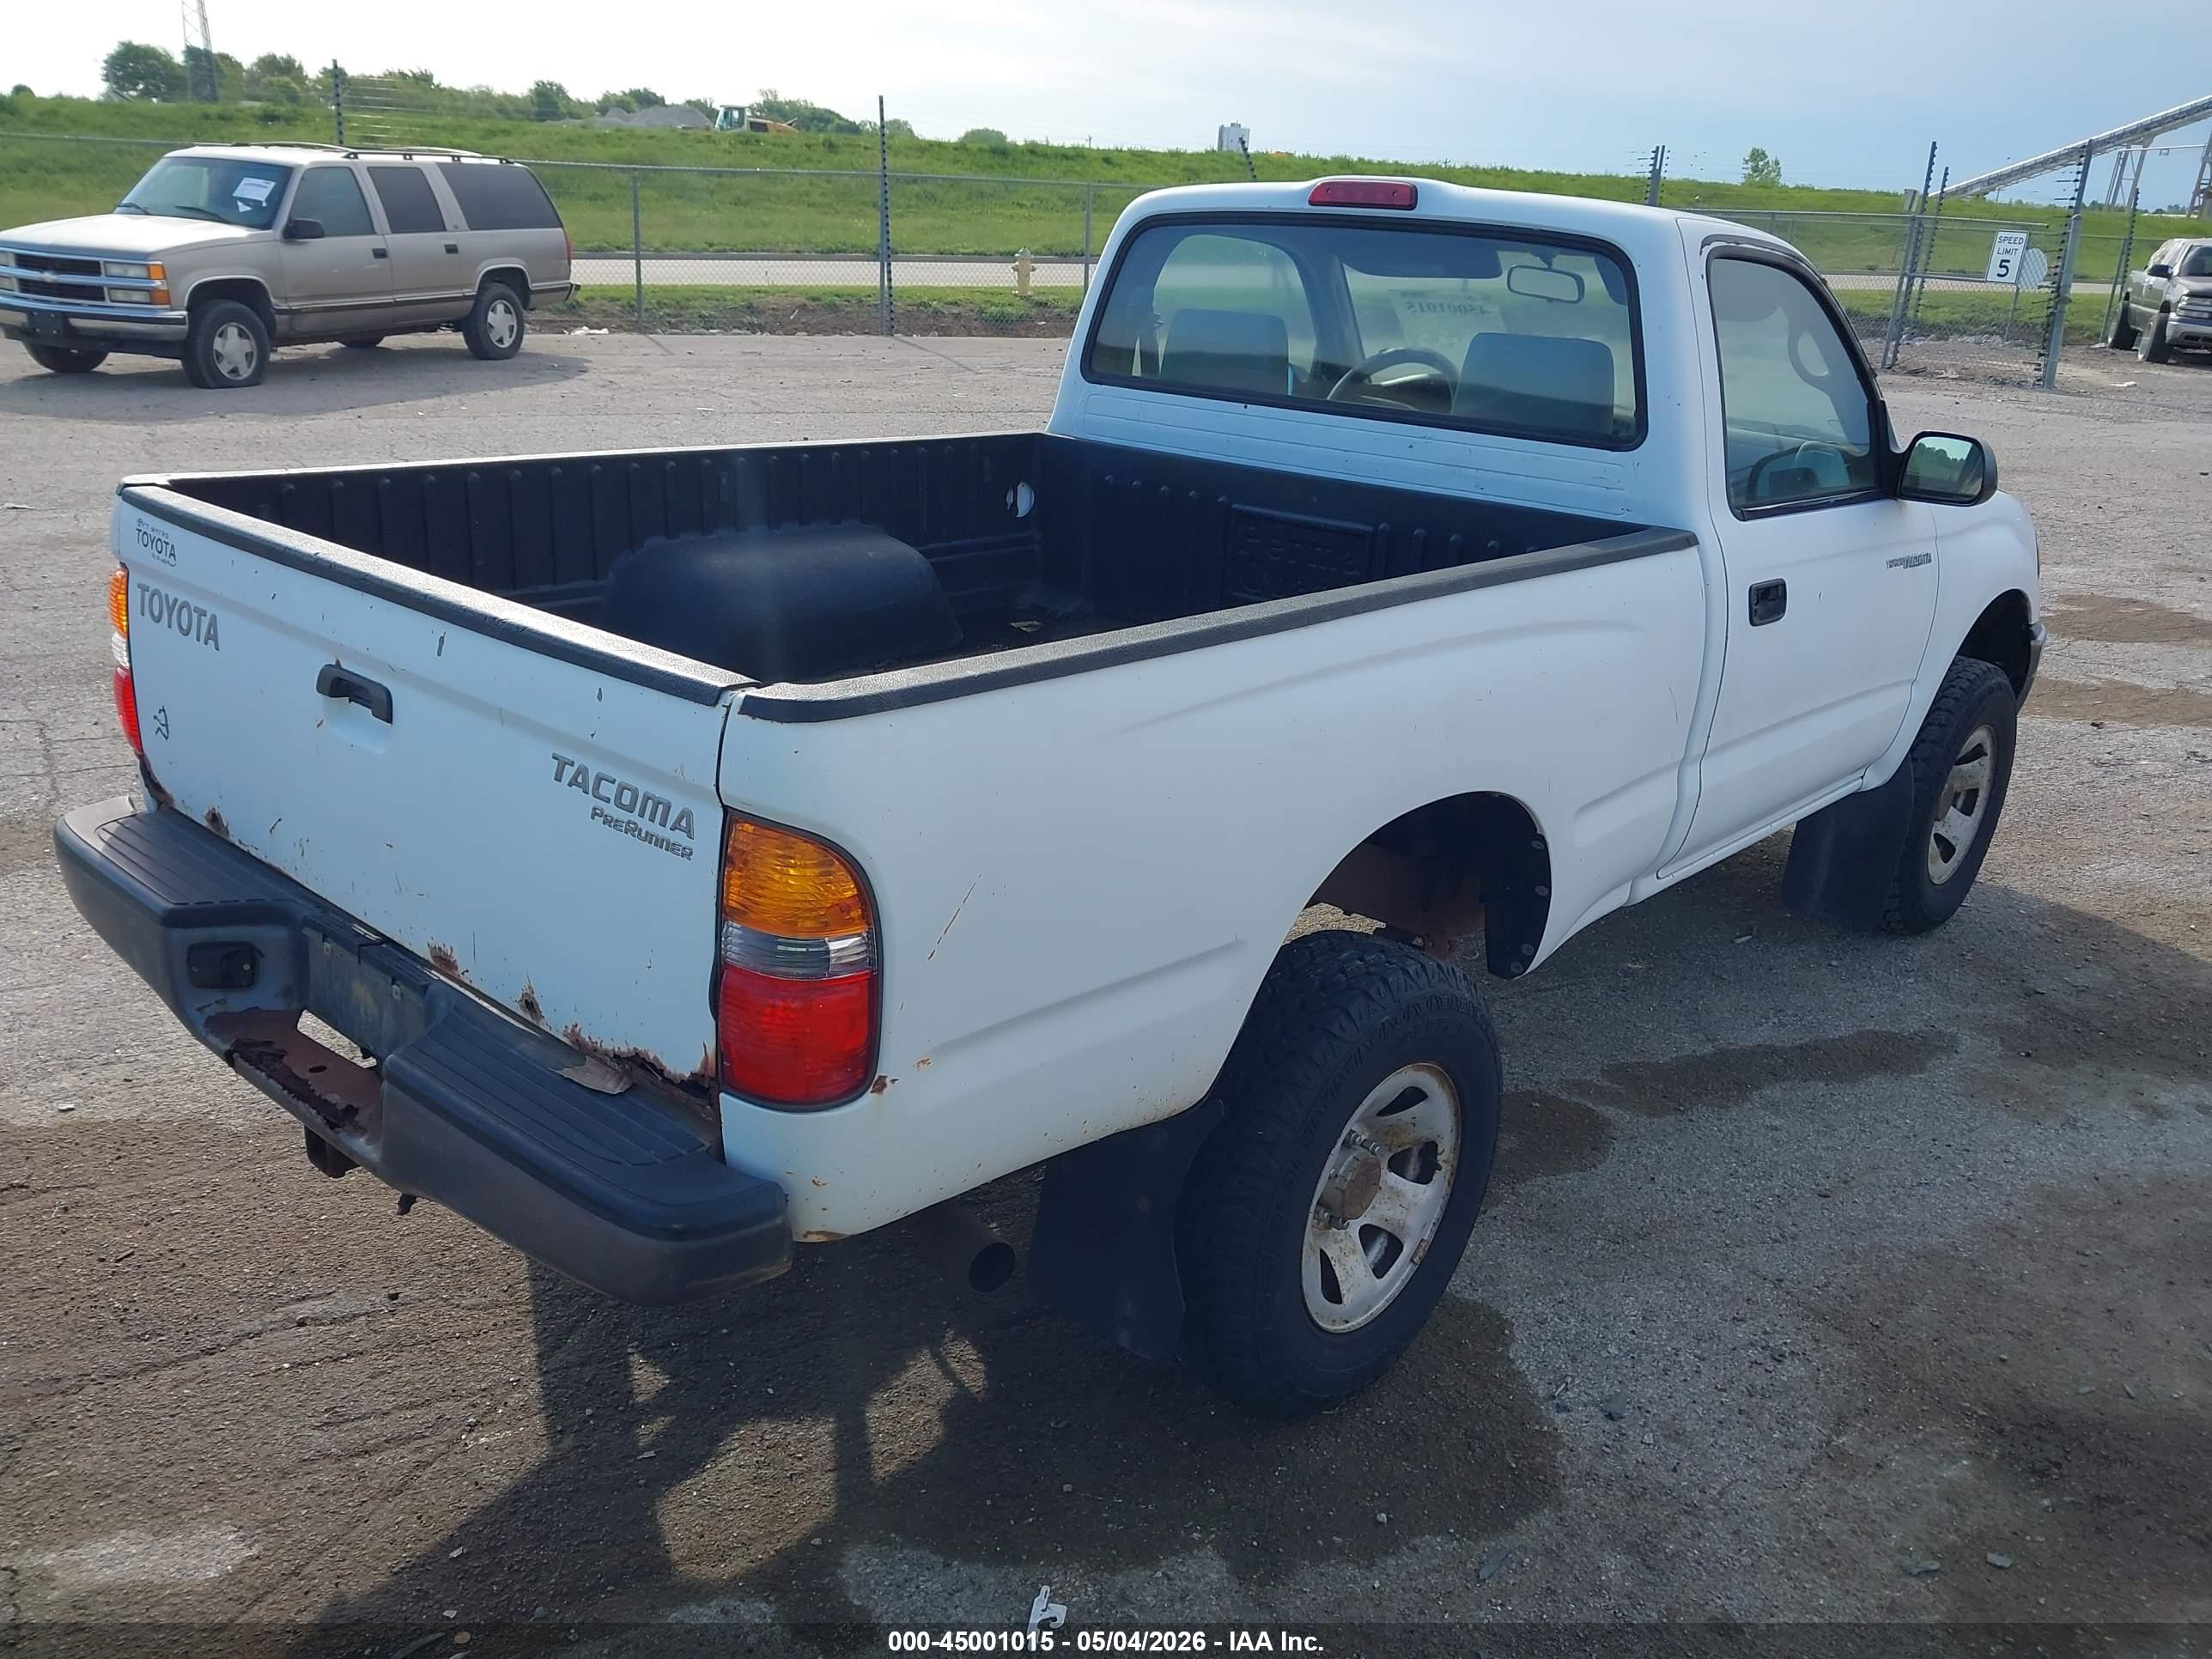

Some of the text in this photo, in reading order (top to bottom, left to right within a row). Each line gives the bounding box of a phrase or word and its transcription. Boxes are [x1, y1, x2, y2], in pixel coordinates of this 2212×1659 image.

[1997, 235, 2024, 244] SPEED
[1997, 247, 2018, 256] LIMIT
[1996, 259, 2010, 278] 5
[136, 528, 177, 561] TOYOTA
[137, 582, 219, 652] TOYOTA
[551, 752, 695, 841] TACOMA
